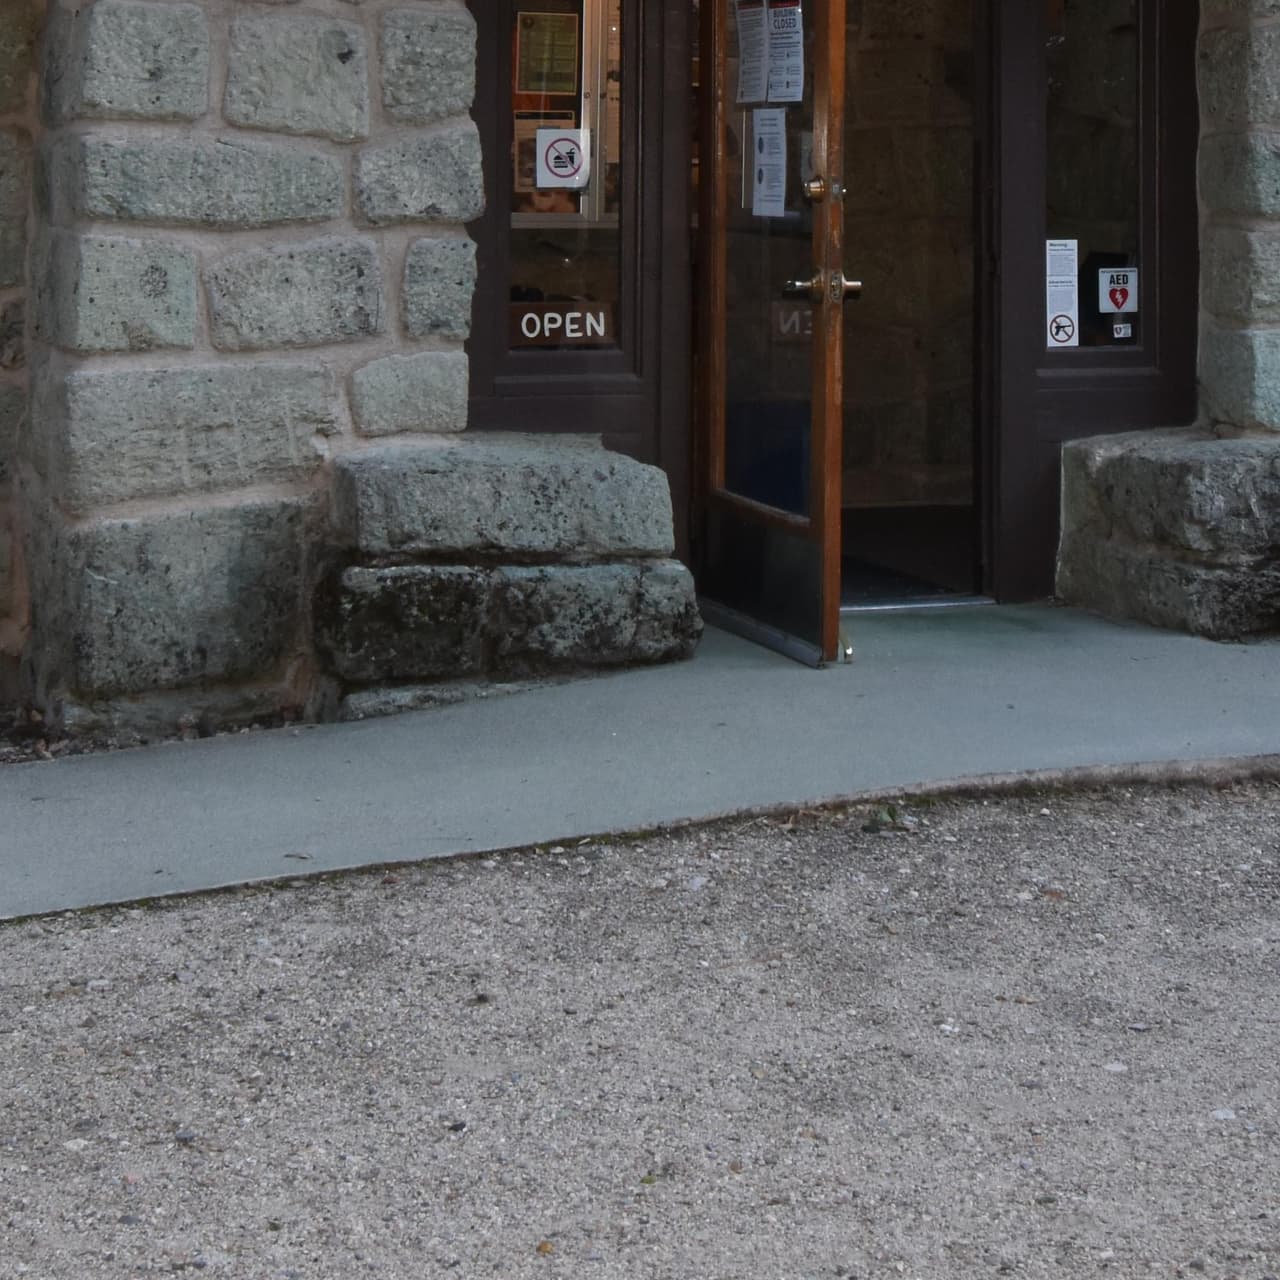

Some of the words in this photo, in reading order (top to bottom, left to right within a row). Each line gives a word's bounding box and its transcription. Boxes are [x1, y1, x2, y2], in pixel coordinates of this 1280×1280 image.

[773, 18, 797, 29] CLOSED
[1109, 274, 1129, 285] AED
[521, 312, 605, 338] OPEN
